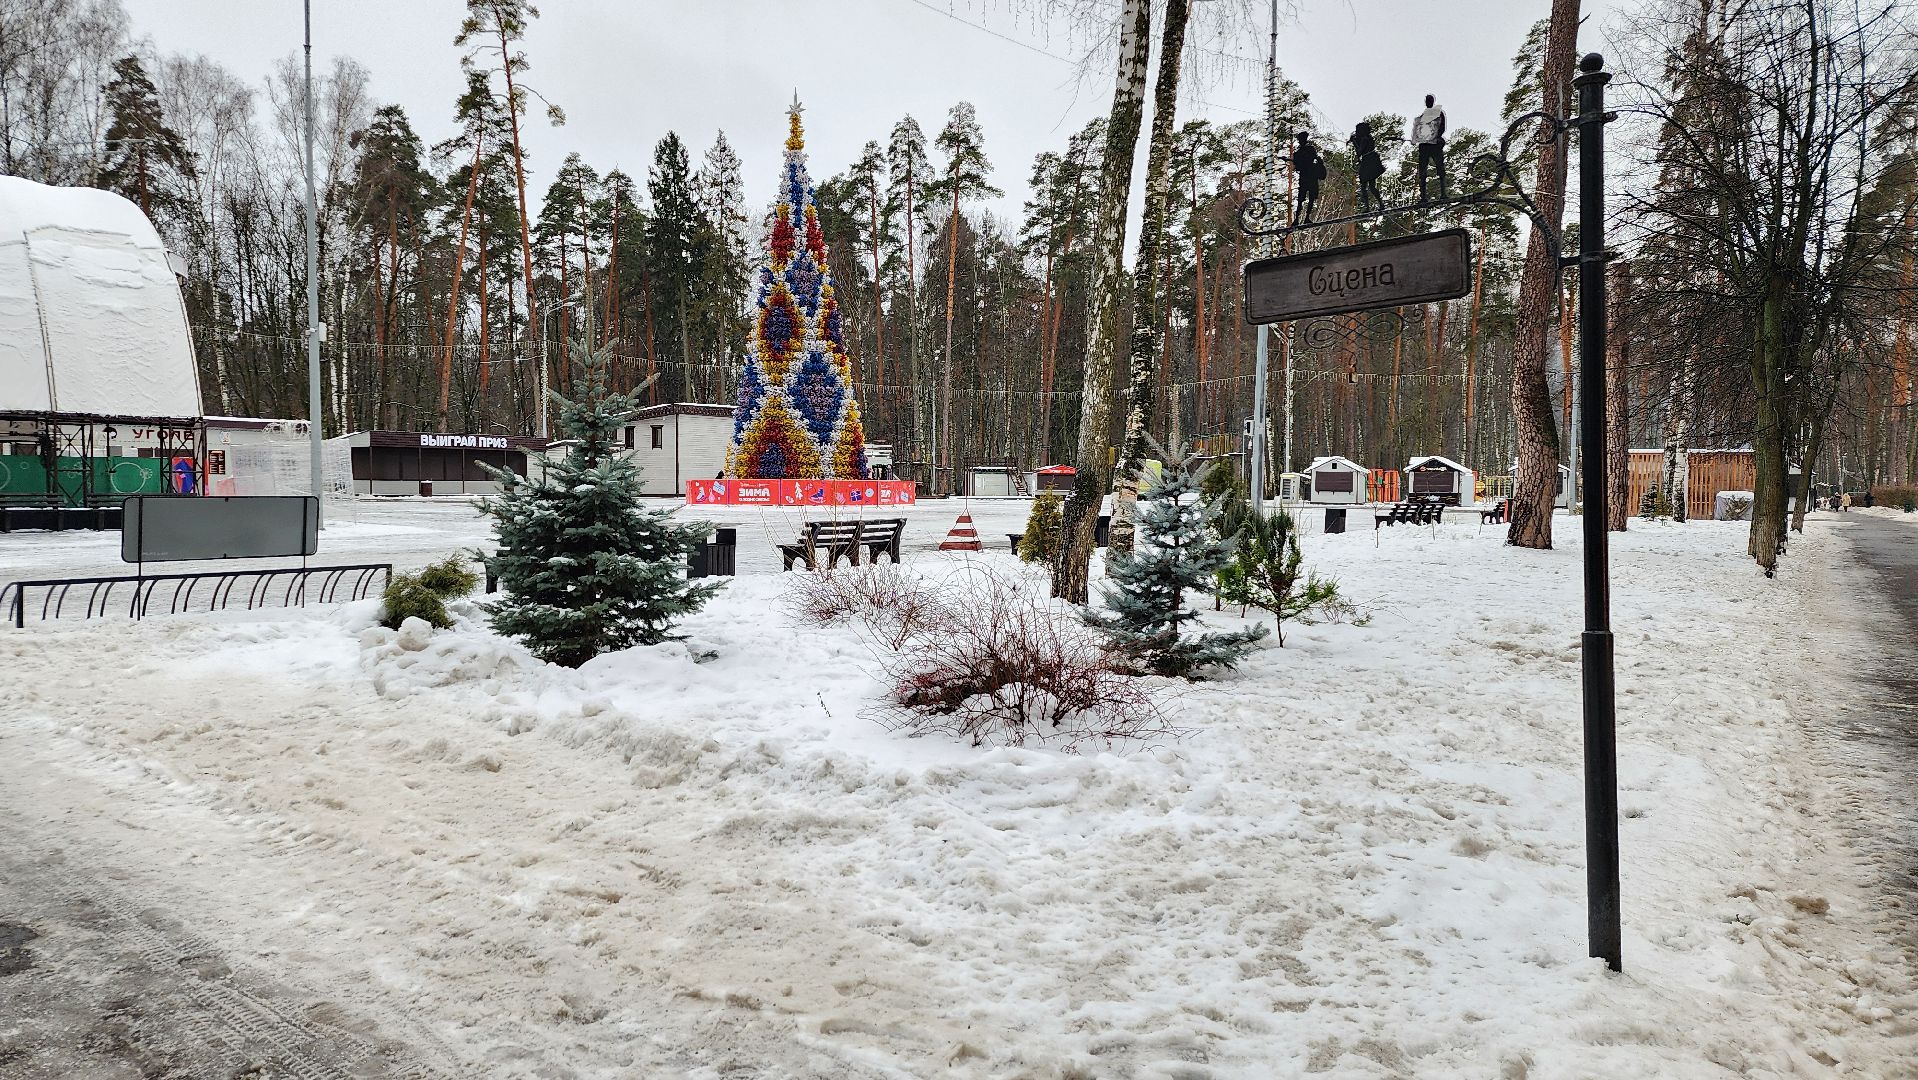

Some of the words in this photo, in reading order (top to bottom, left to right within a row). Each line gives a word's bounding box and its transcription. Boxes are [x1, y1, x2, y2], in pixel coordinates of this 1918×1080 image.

[1308, 263, 1395, 297] Сцена
[420, 434, 476, 447] ВЫИГРАЙ
[479, 436, 508, 448] ПРИЗ
[738, 487, 770, 497] ЗИМА
